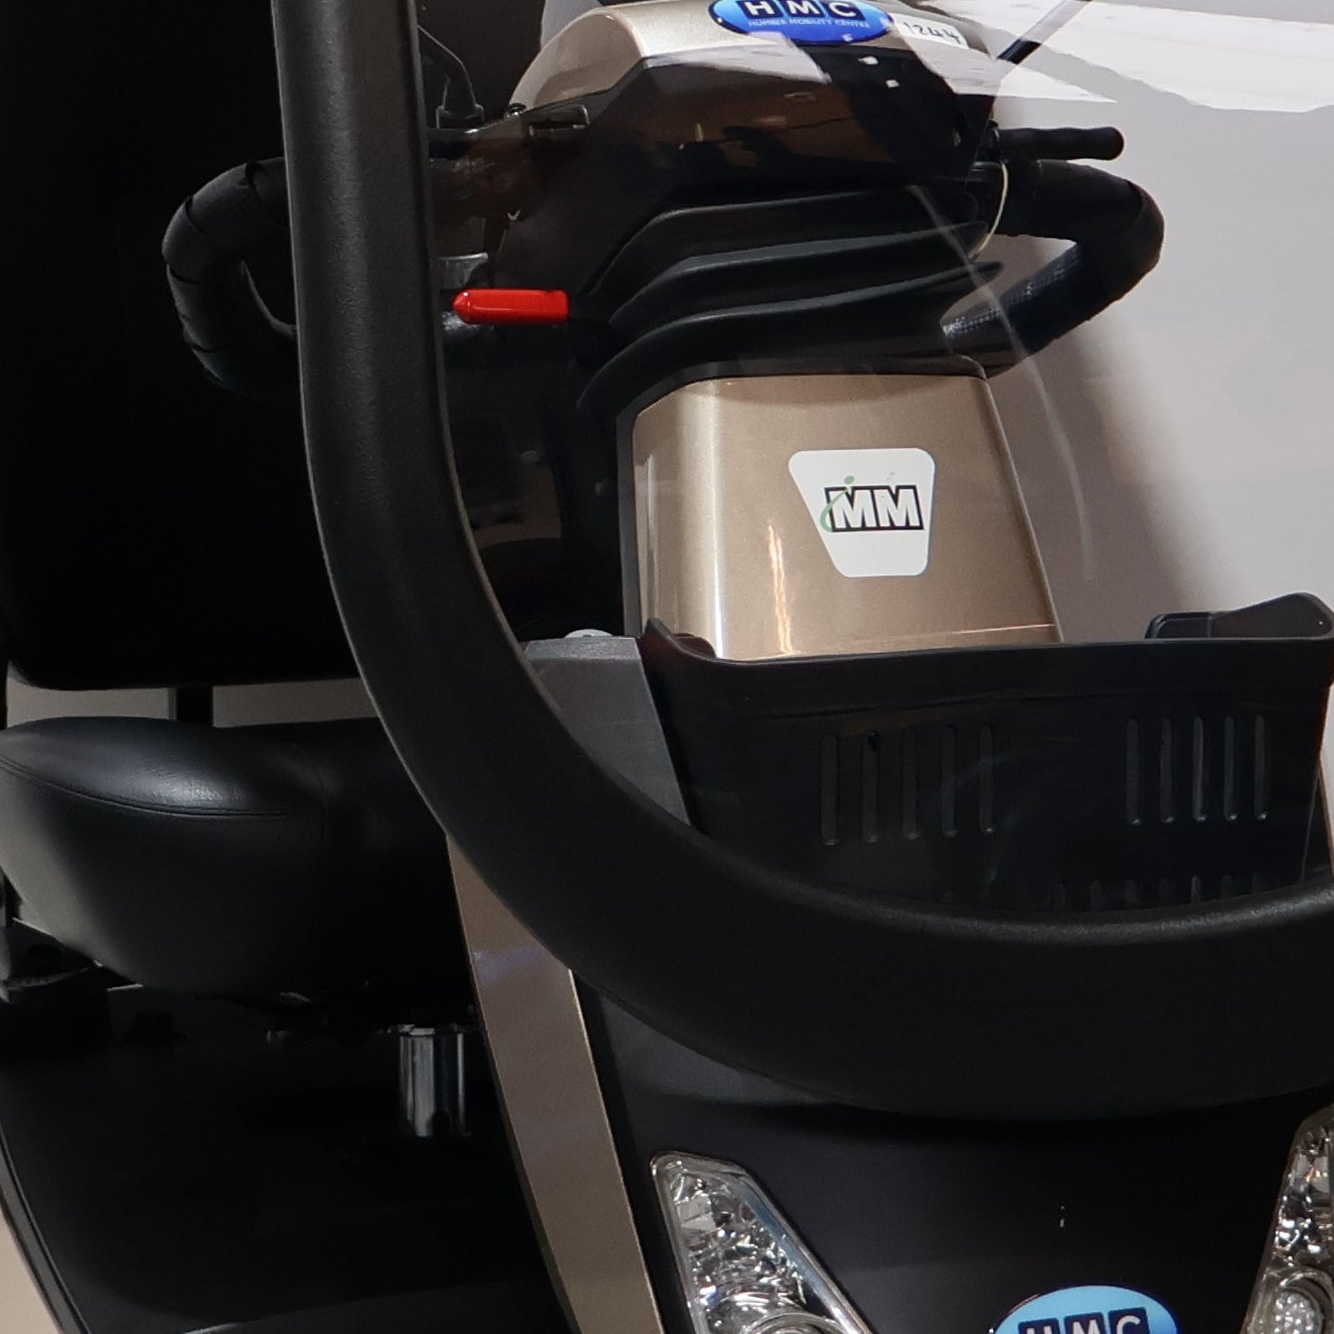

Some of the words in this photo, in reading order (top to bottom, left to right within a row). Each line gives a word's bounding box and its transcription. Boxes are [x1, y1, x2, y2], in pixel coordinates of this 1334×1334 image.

[743, 0, 857, 17] HMC
[789, 18, 832, 26] MOBILITY
[902, 21, 962, 45] 1244
